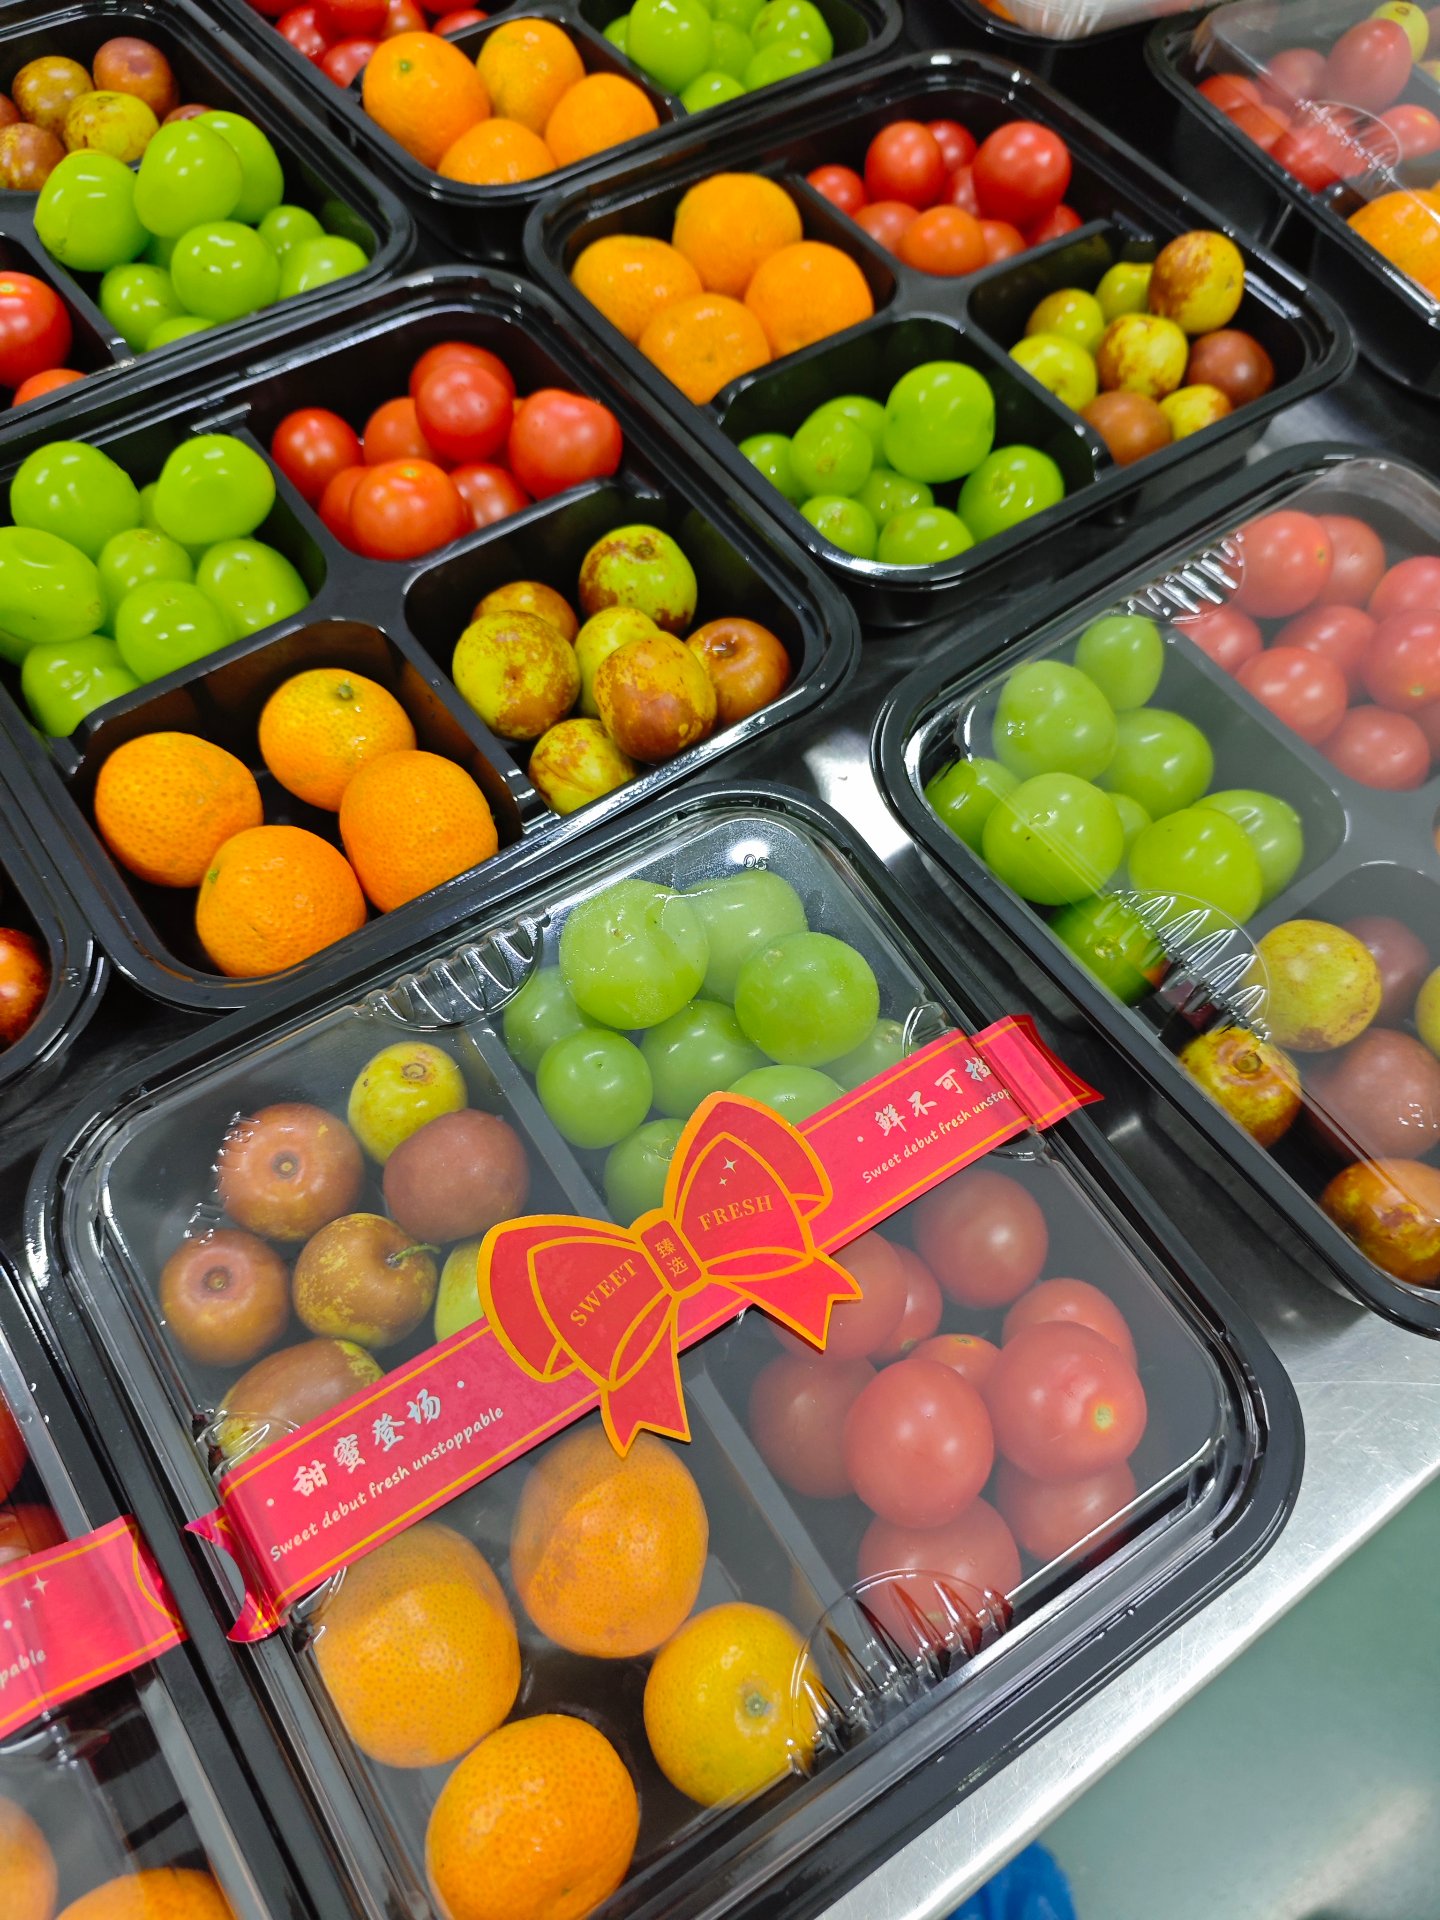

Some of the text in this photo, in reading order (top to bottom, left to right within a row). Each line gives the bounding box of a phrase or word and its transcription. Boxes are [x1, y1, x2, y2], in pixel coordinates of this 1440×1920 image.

[861, 1153, 902, 1184] Sweet
[903, 1129, 939, 1159] debut
[938, 1107, 972, 1136] fresh
[697, 1194, 774, 1232] FRESH
[569, 1258, 639, 1327] SWEET
[654, 1237, 689, 1278] 臻选
[291, 1388, 442, 1497] 甜蜜登场
[269, 1405, 505, 1563] Sweet debut fresh unstoppable
